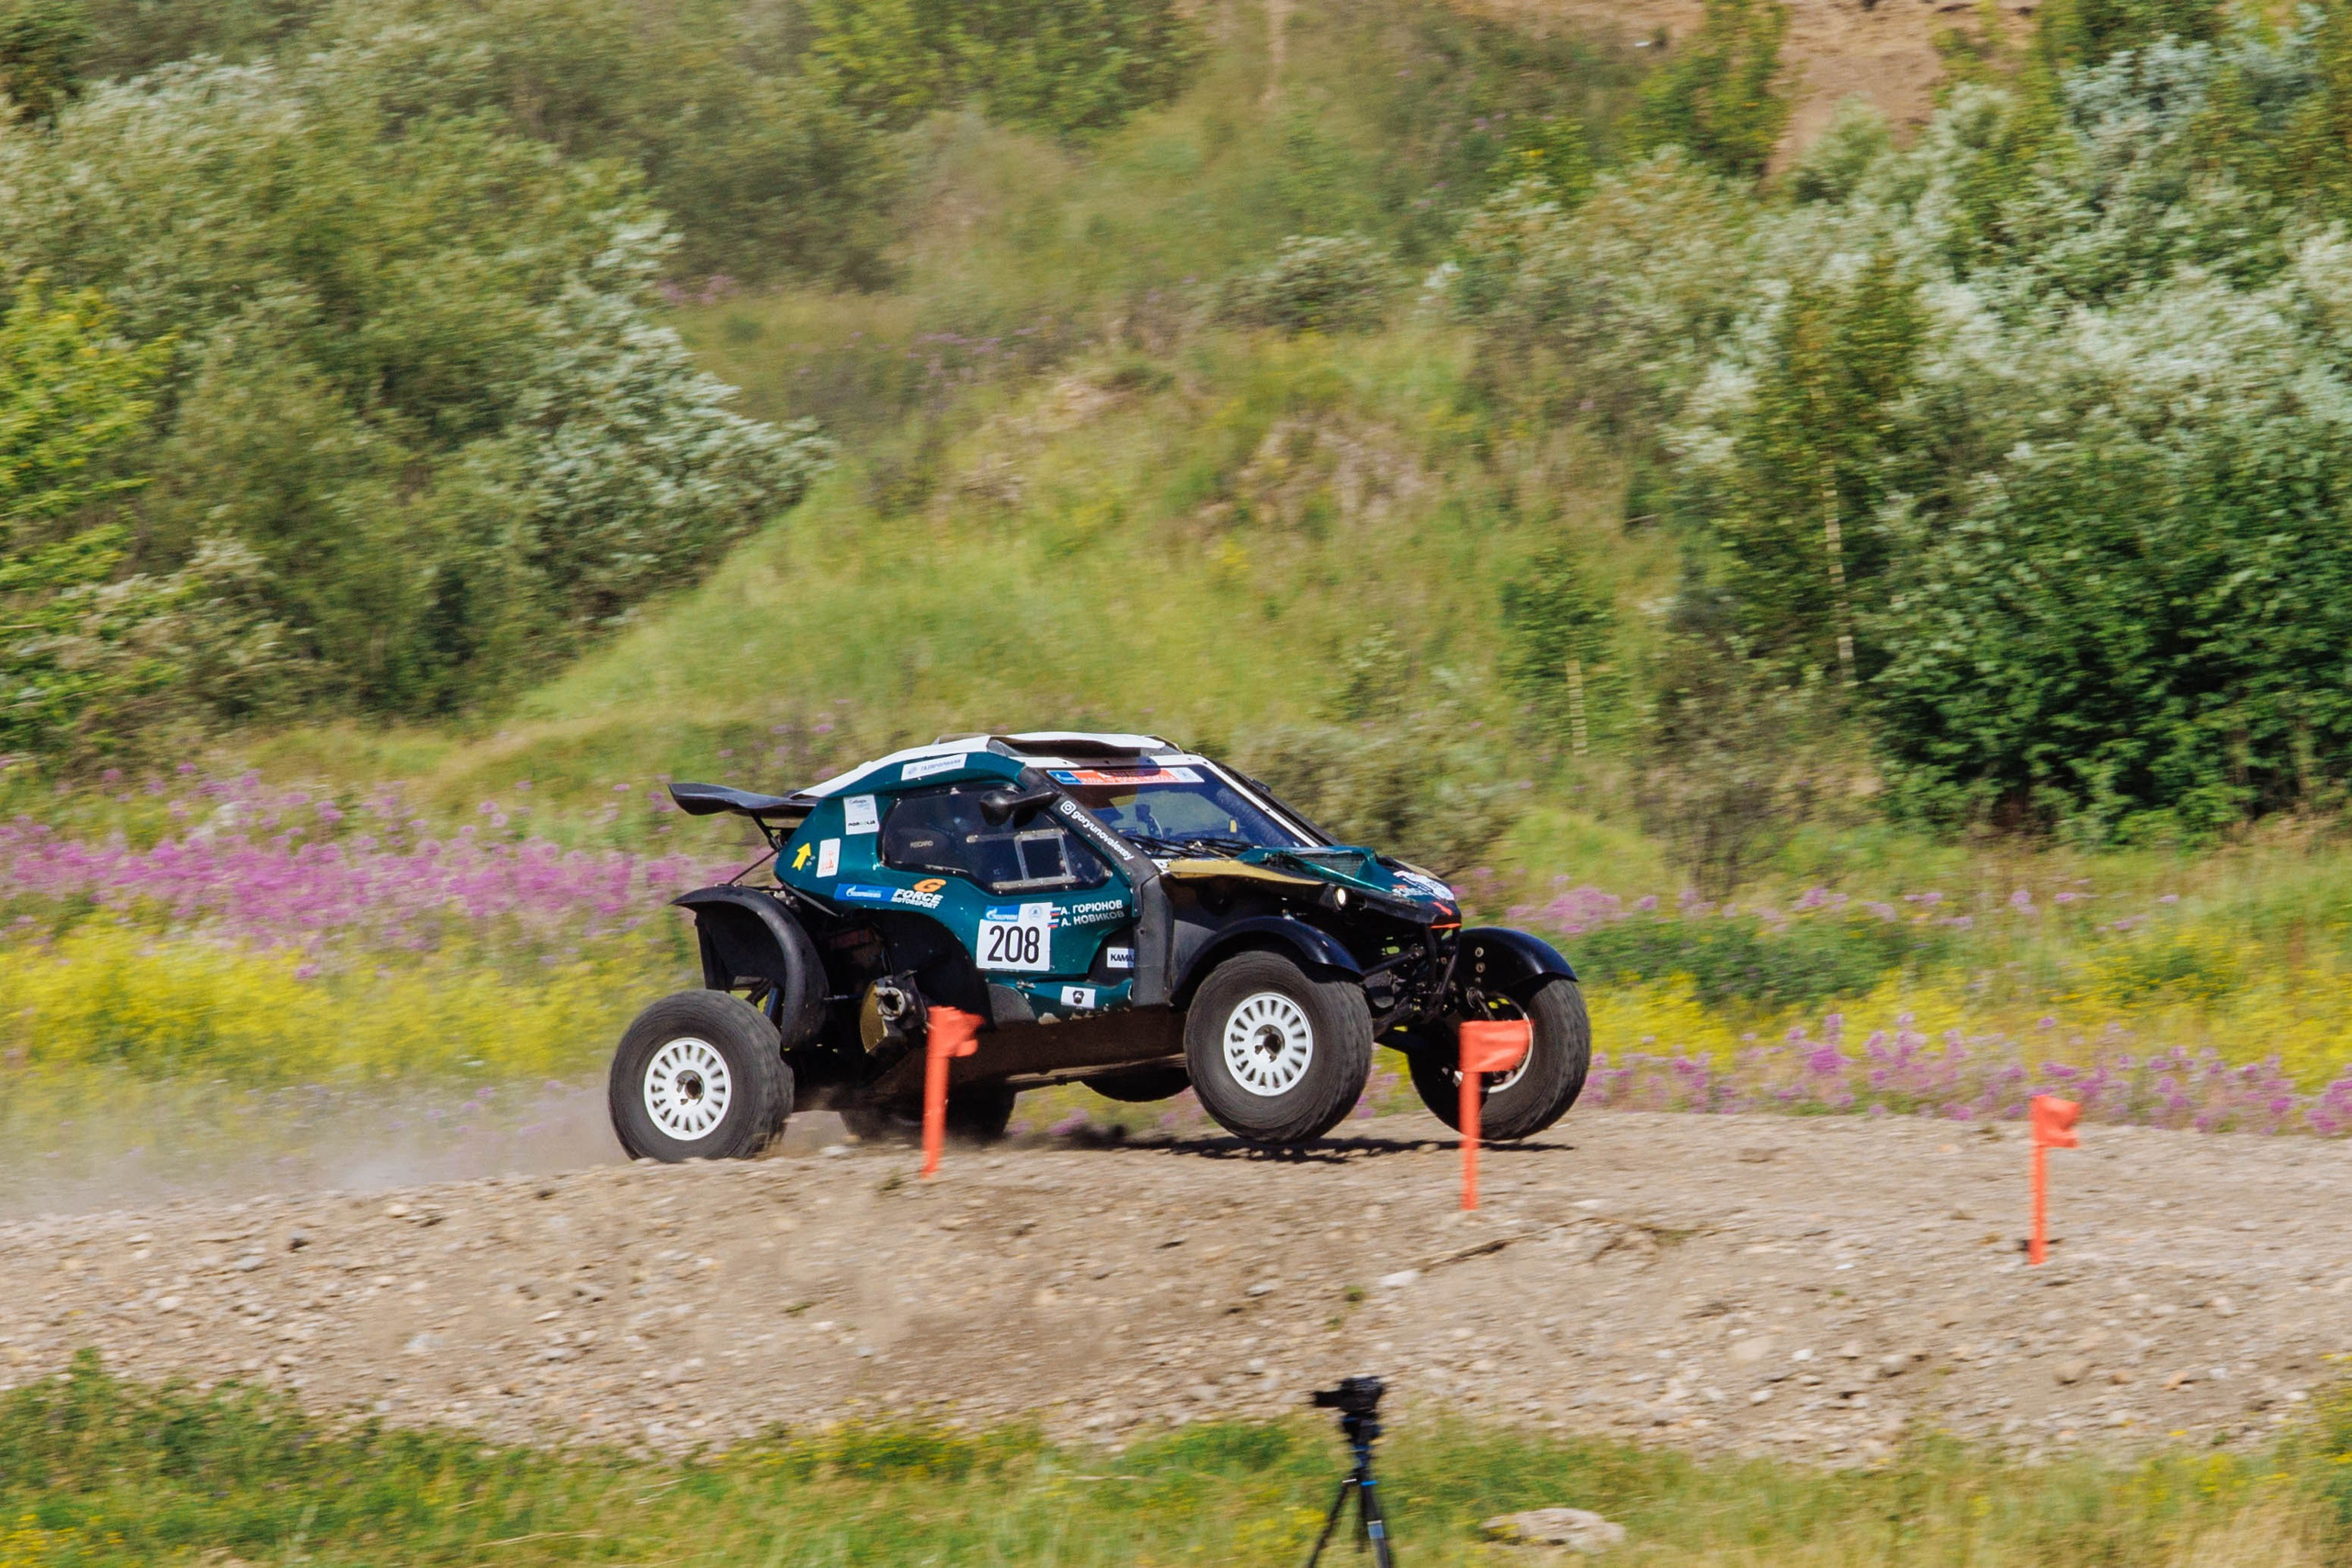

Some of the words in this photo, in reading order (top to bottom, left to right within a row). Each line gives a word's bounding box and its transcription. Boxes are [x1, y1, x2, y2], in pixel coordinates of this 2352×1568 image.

[1071, 811, 1135, 861] goryunovalexey
[890, 897, 939, 909] MOTORSPORT
[891, 888, 944, 905] FORCE
[1073, 899, 1123, 914] ГОРЮНОВ
[1073, 910, 1125, 925] НОВИКОВ
[988, 925, 1040, 964] 208
